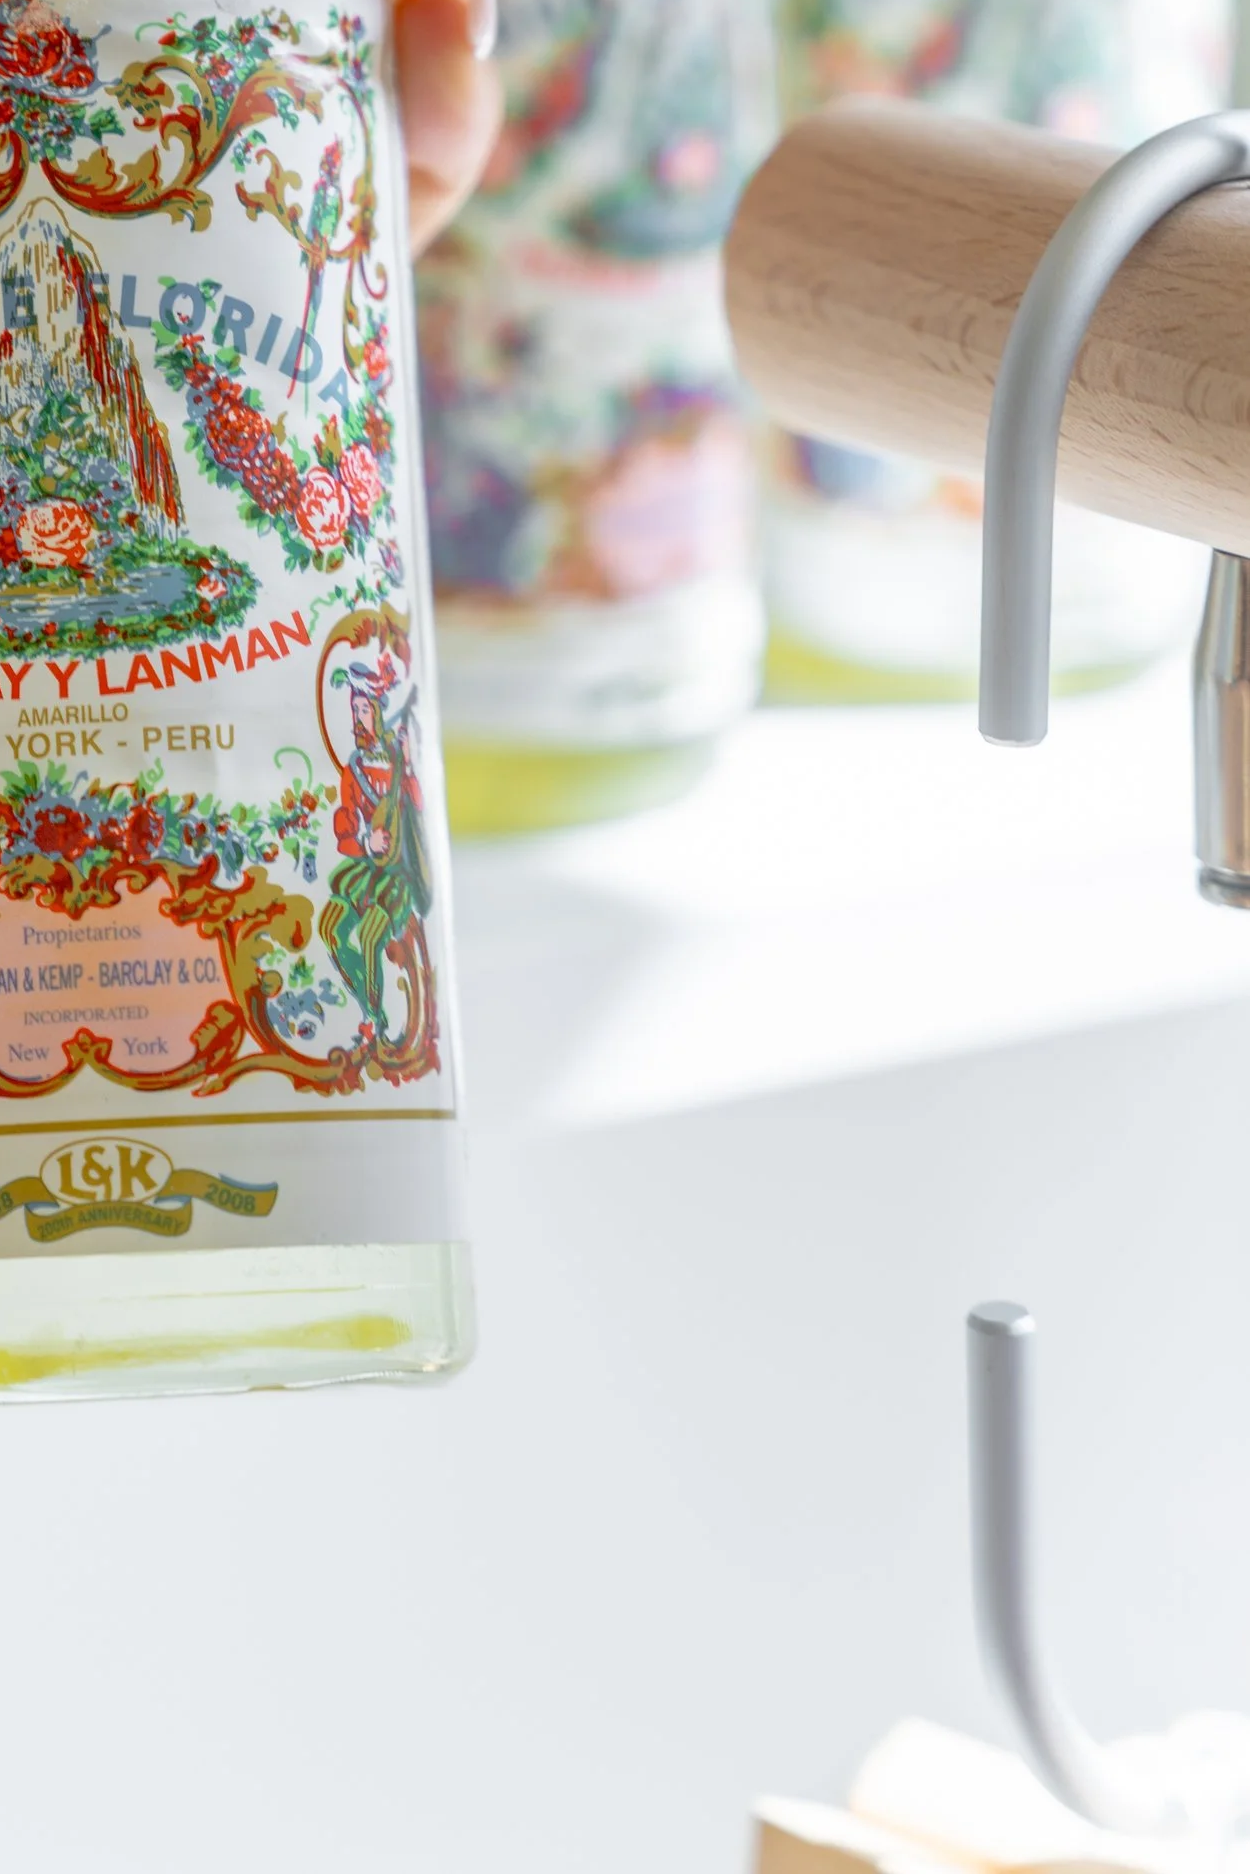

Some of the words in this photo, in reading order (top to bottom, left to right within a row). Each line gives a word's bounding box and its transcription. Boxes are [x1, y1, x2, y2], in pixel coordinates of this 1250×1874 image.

[77, 273, 353, 424] FLORIDA
[45, 659, 80, 700] Y
[95, 609, 313, 697] LANMAN
[17, 702, 129, 727] AMARILLO
[6, 729, 104, 760] YORK
[142, 724, 236, 752] PERU
[22, 923, 142, 949] Propietarios
[23, 967, 35, 993] &
[38, 963, 84, 991] KEMP
[99, 958, 173, 988] BARCLAY
[178, 961, 190, 984] &
[193, 957, 220, 984] CO.
[23, 1005, 149, 1026] INCORPORATED
[7, 1043, 50, 1063] New
[122, 1036, 168, 1057] York
[56, 1144, 158, 1201] L&K
[205, 1182, 256, 1215] 2008
[37, 1215, 74, 1239] 200th
[77, 1205, 186, 1237] ANNIVERSARY
